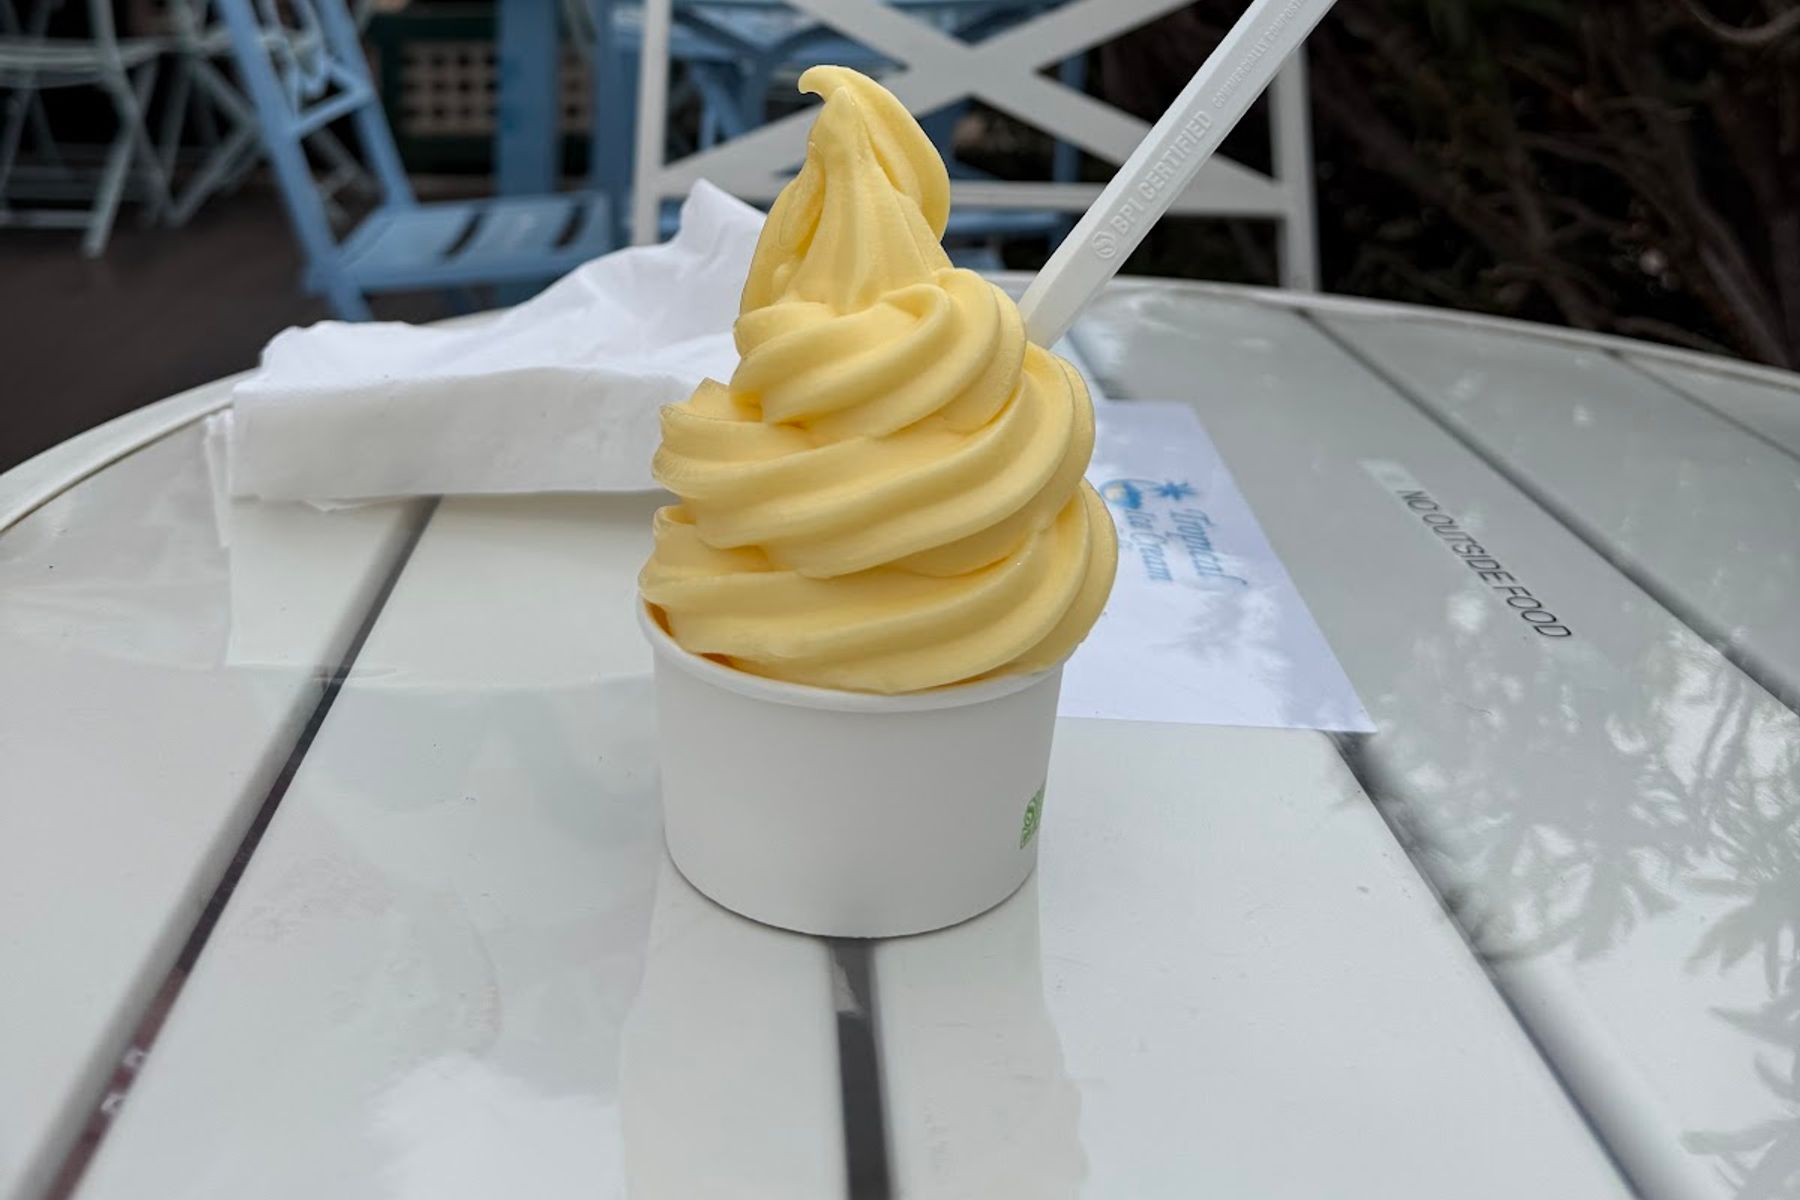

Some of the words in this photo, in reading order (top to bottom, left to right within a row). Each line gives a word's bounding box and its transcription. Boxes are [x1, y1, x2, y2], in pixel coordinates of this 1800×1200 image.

[1110, 198, 1144, 234] BPI
[1137, 109, 1214, 200] CERTIFIED
[1165, 508, 1249, 587] Tropical
[1396, 490, 1438, 511] NO
[1422, 514, 1516, 582] OUTSIDE
[1493, 586, 1572, 637] FOOD
